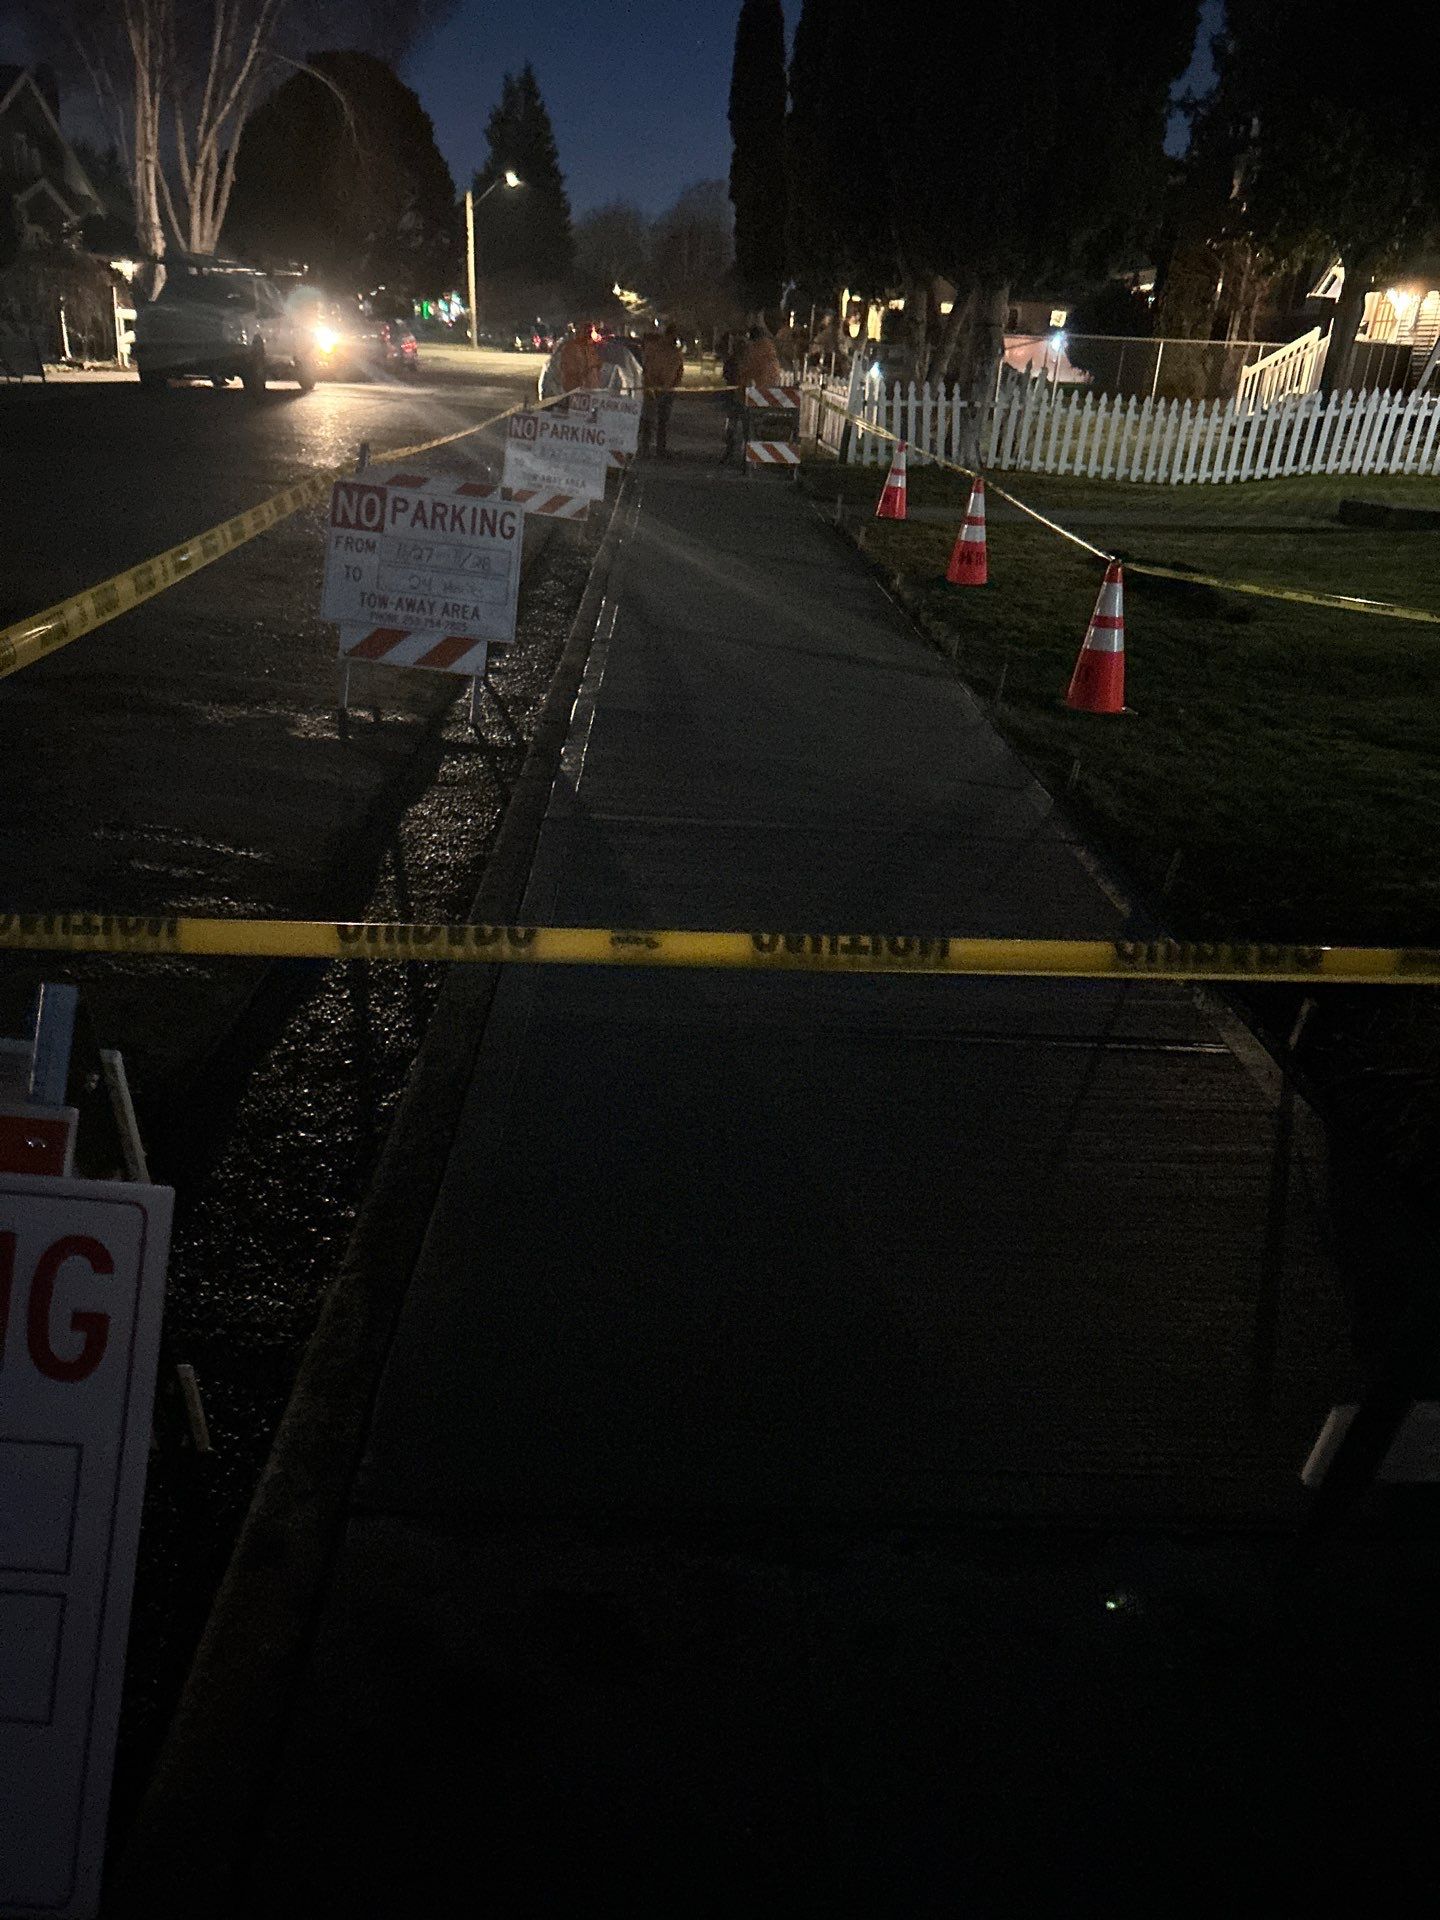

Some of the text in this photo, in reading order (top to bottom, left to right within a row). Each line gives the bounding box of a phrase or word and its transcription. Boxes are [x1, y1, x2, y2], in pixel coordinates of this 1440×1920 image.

[511, 416, 537, 438] NO
[540, 423, 606, 447] PARKING
[335, 487, 516, 540] NO PARKING
[334, 535, 377, 554] FROM
[345, 565, 362, 582] TO
[360, 592, 480, 621] TOW-AWAY AREA
[0, 1231, 114, 1382] G
